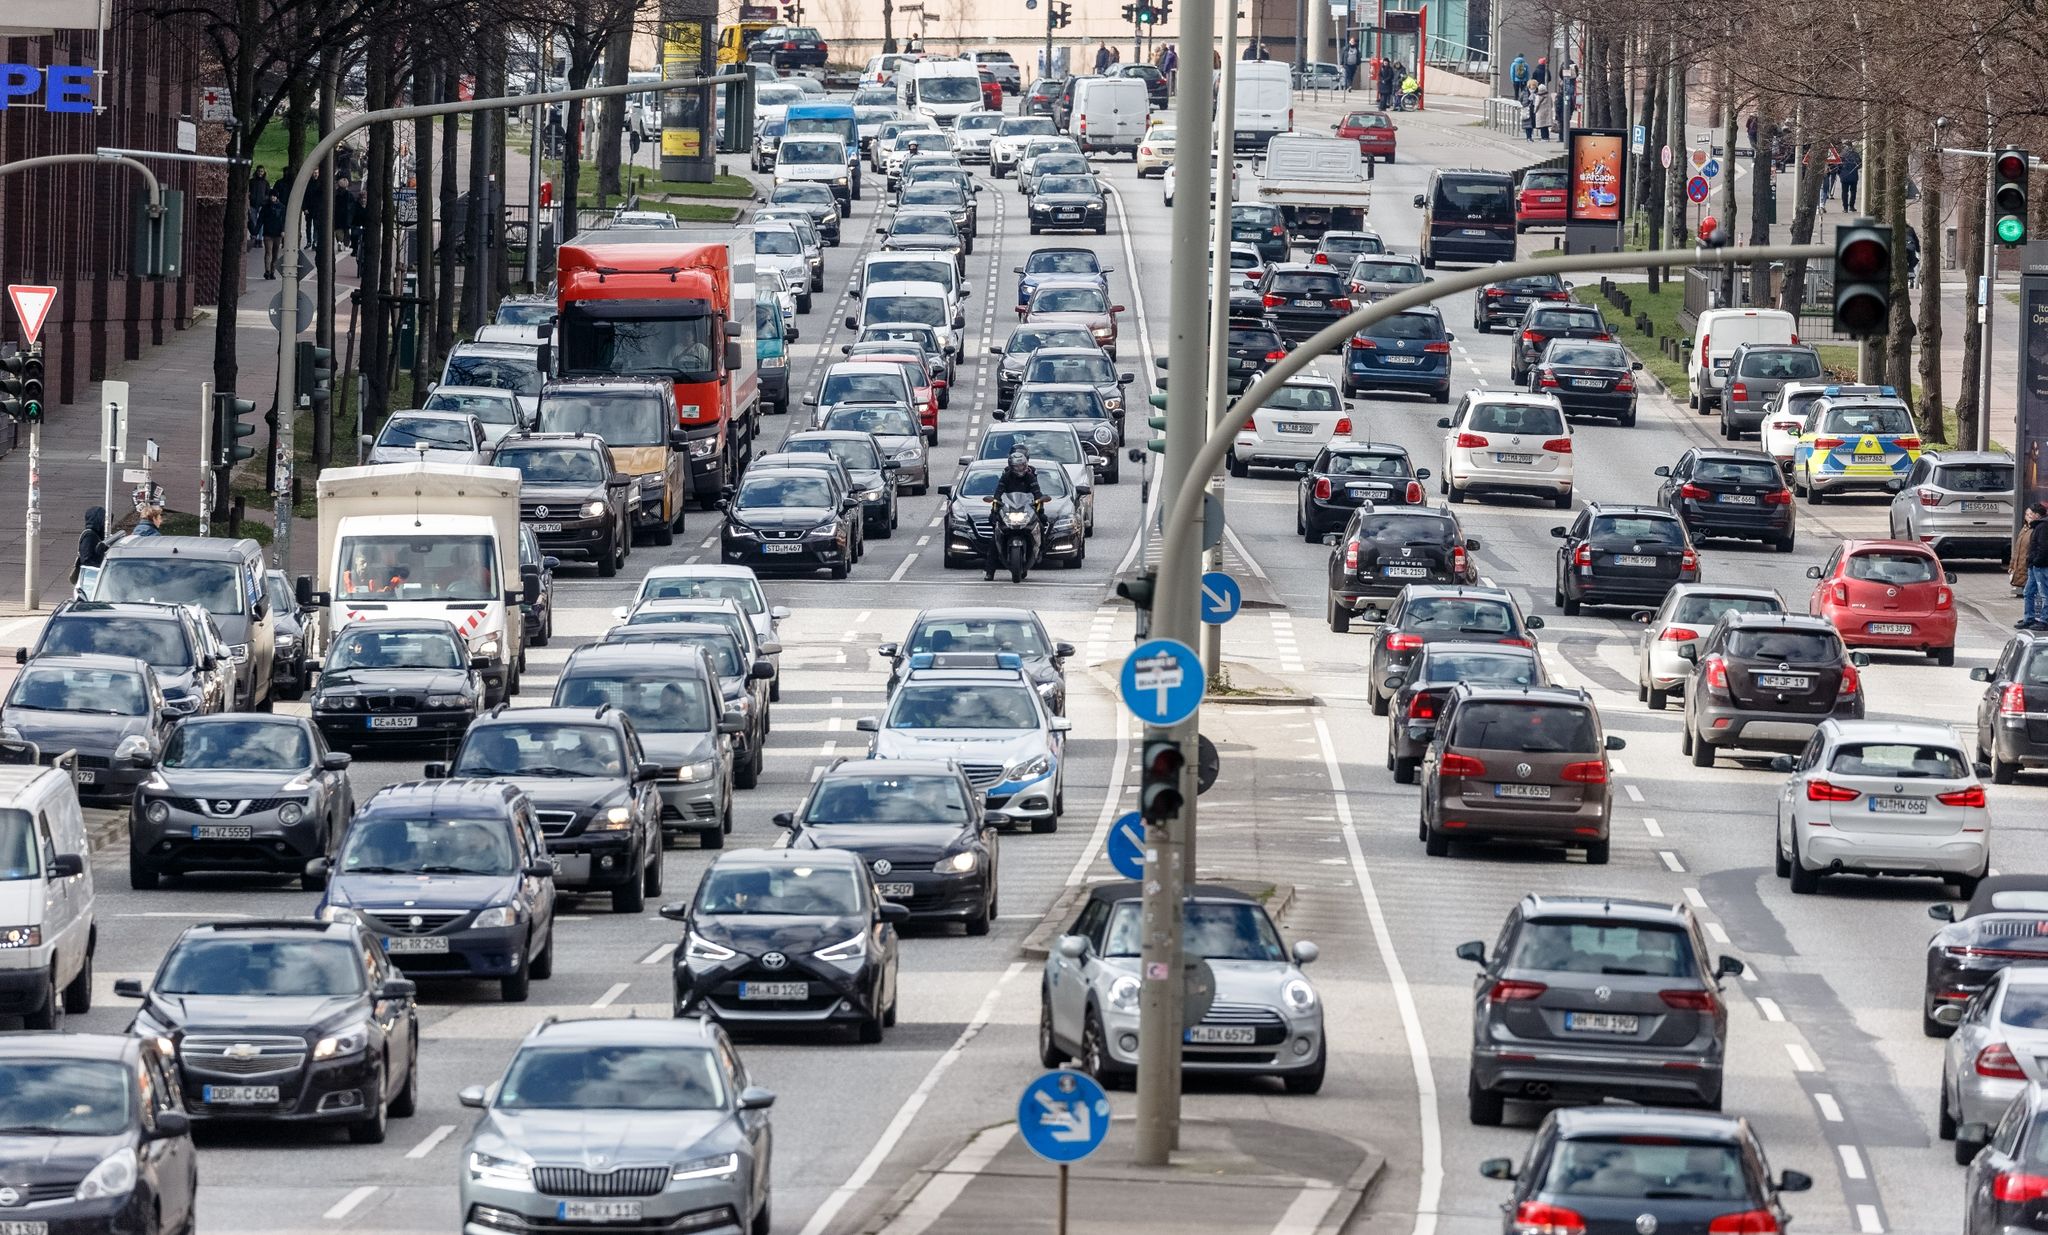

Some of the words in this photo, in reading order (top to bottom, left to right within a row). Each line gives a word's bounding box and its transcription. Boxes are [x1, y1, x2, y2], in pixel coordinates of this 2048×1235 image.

[0, 64, 93, 113] PE
[1586, 172, 1615, 182] Arcade
[1794, 678, 1805, 686] 19
[374, 718, 385, 727] CE
[390, 718, 397, 726] A
[397, 717, 414, 726] 517
[1908, 800, 1926, 810] 666
[200, 827, 210, 837] HH
[228, 827, 250, 837] 5555
[1224, 1028, 1253, 1041] 6575
[244, 1087, 251, 1100] C
